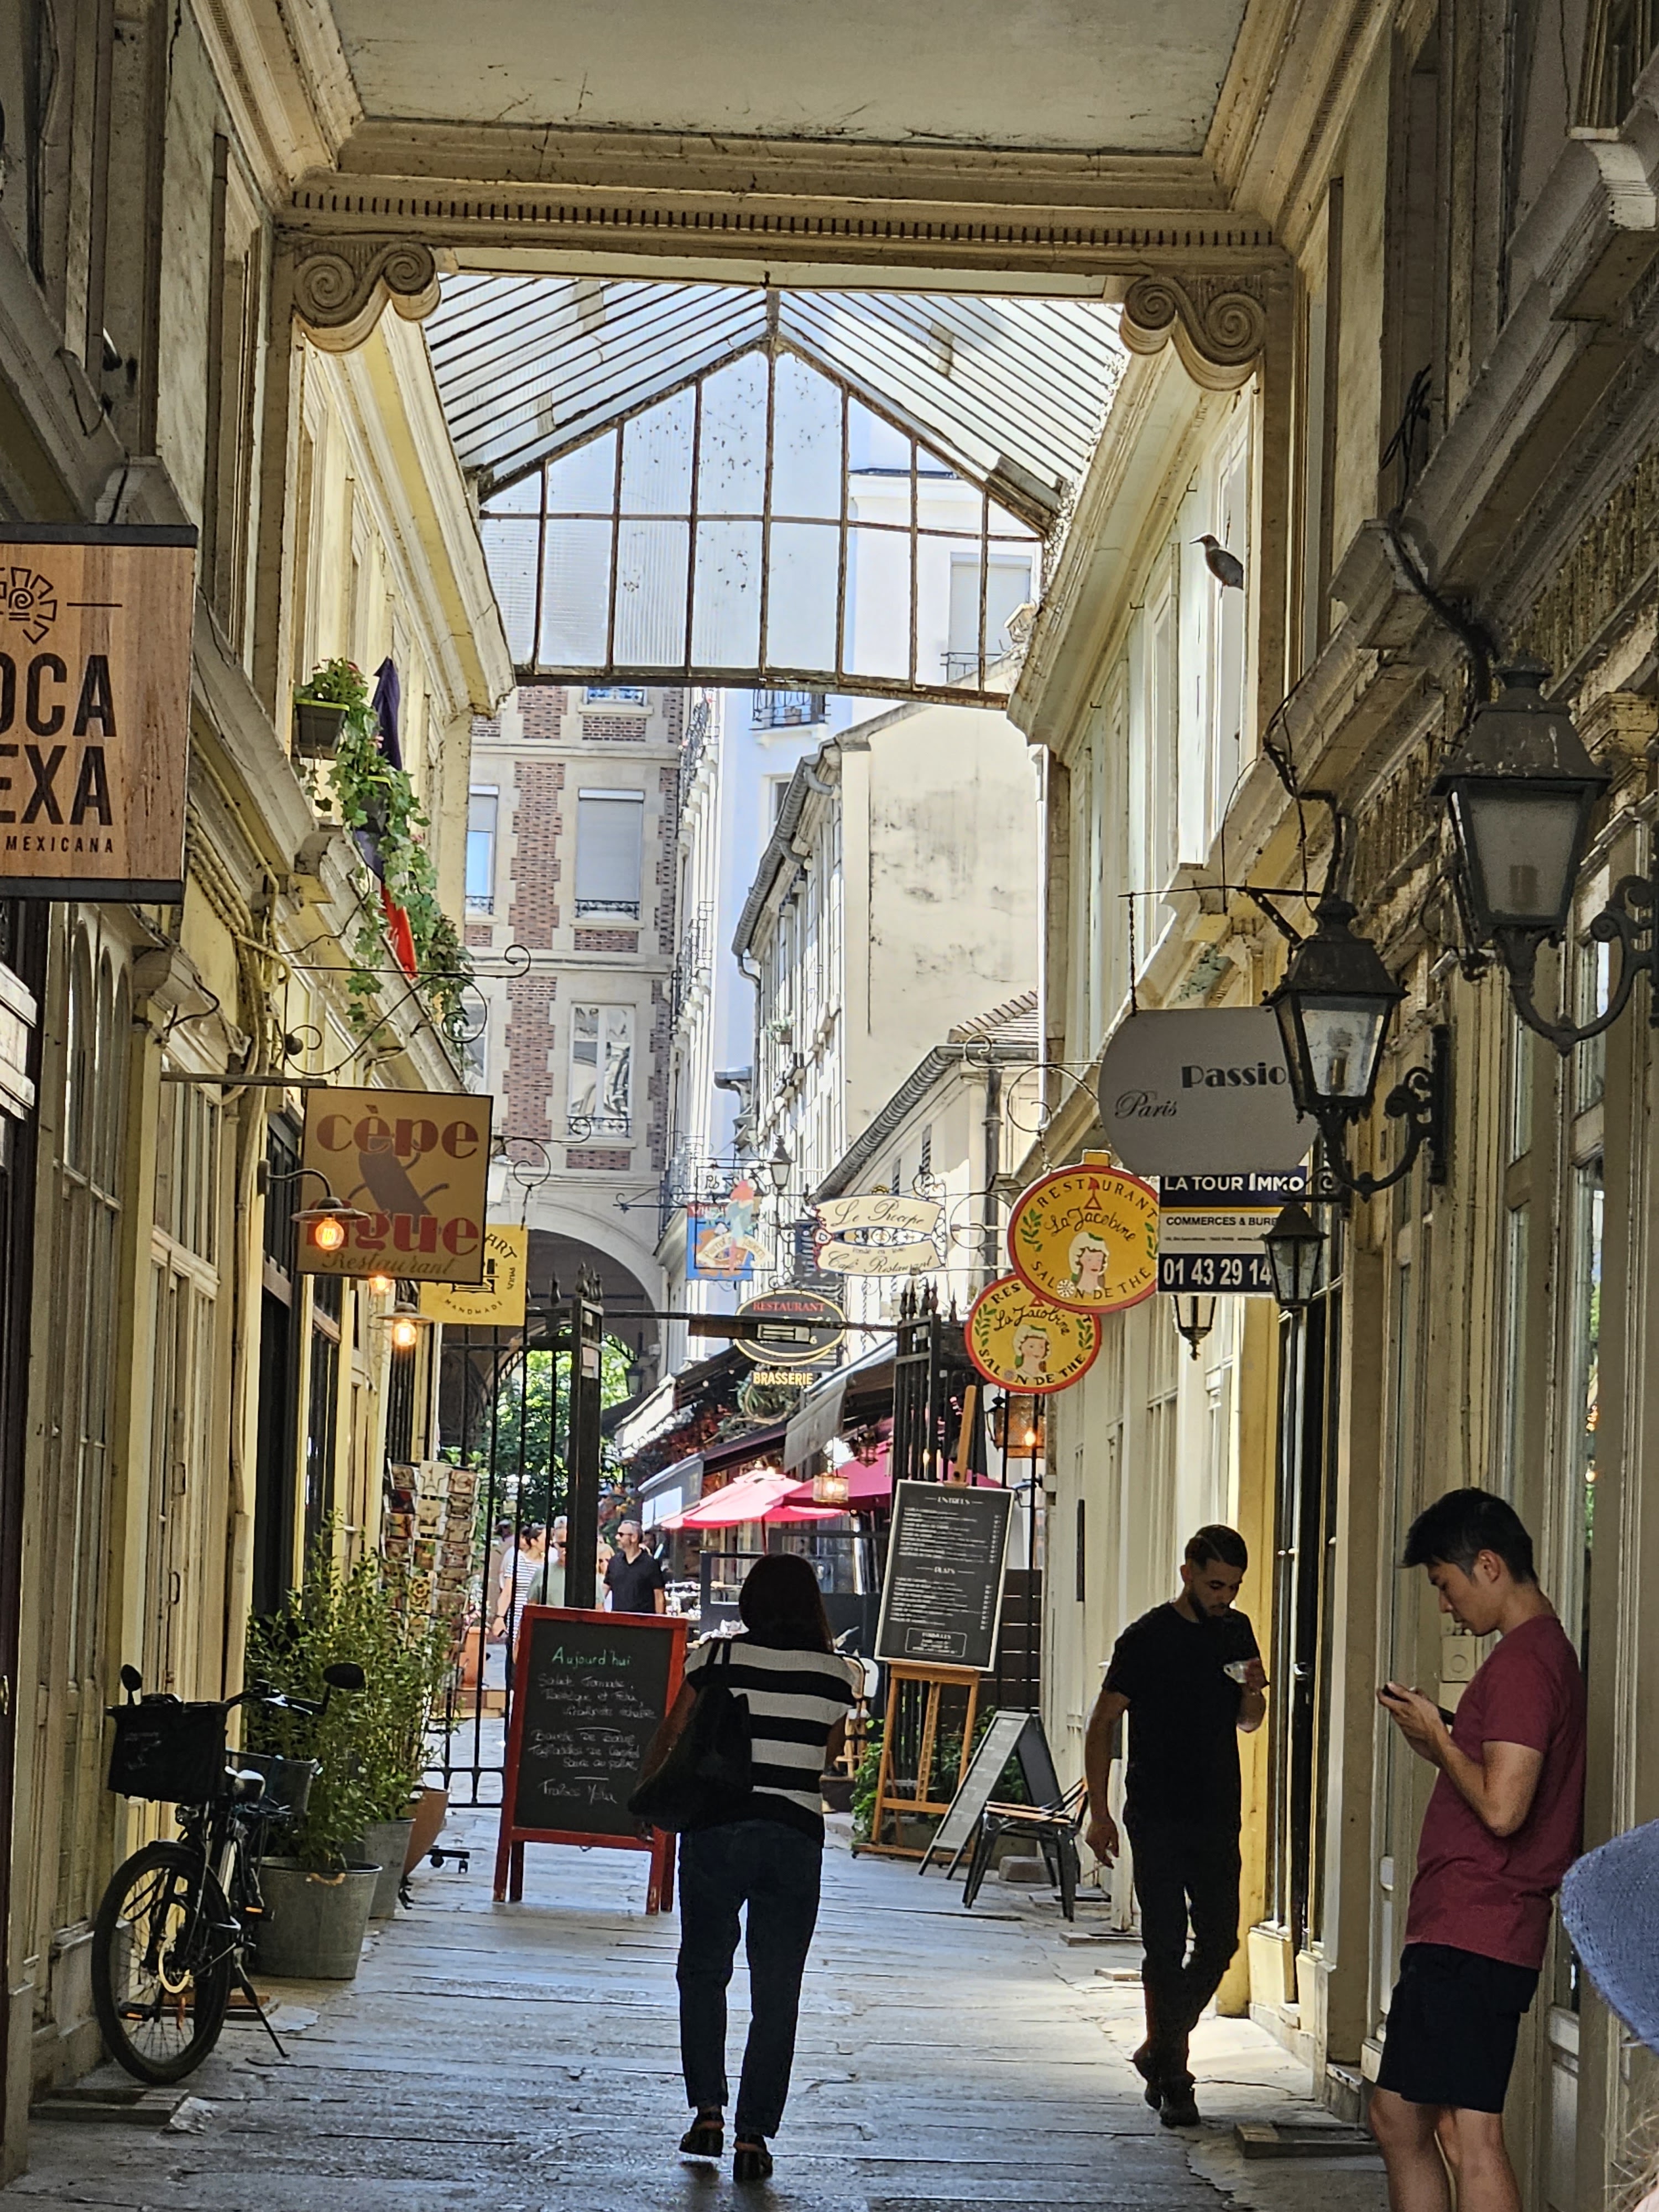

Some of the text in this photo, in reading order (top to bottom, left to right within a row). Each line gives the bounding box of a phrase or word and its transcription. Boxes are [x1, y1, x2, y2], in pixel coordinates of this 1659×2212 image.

[6, 835, 113, 853] MEXICANA
[1181, 1062, 1291, 1088] Passio
[1115, 1089, 1177, 1119] Paris
[1164, 1176, 1188, 1191] LA
[1191, 1176, 1244, 1191] TOUR
[306, 1198, 479, 1256] gue
[1044, 1207, 1136, 1242] La Jacobine
[1166, 1217, 1237, 1226] COMMERCES
[1248, 1217, 1277, 1226] BURE
[322, 1251, 456, 1274] Restaurant
[1164, 1258, 1272, 1286] 01 43 29 14
[1093, 1287, 1114, 1300] DE
[753, 1301, 825, 1312] RESTAURANT
[993, 1305, 1070, 1336] La Jacobine
[753, 1371, 813, 1385] BRASSERIE
[1034, 1373, 1056, 1386] DE
[551, 1646, 632, 1670] Aujourd'hui
